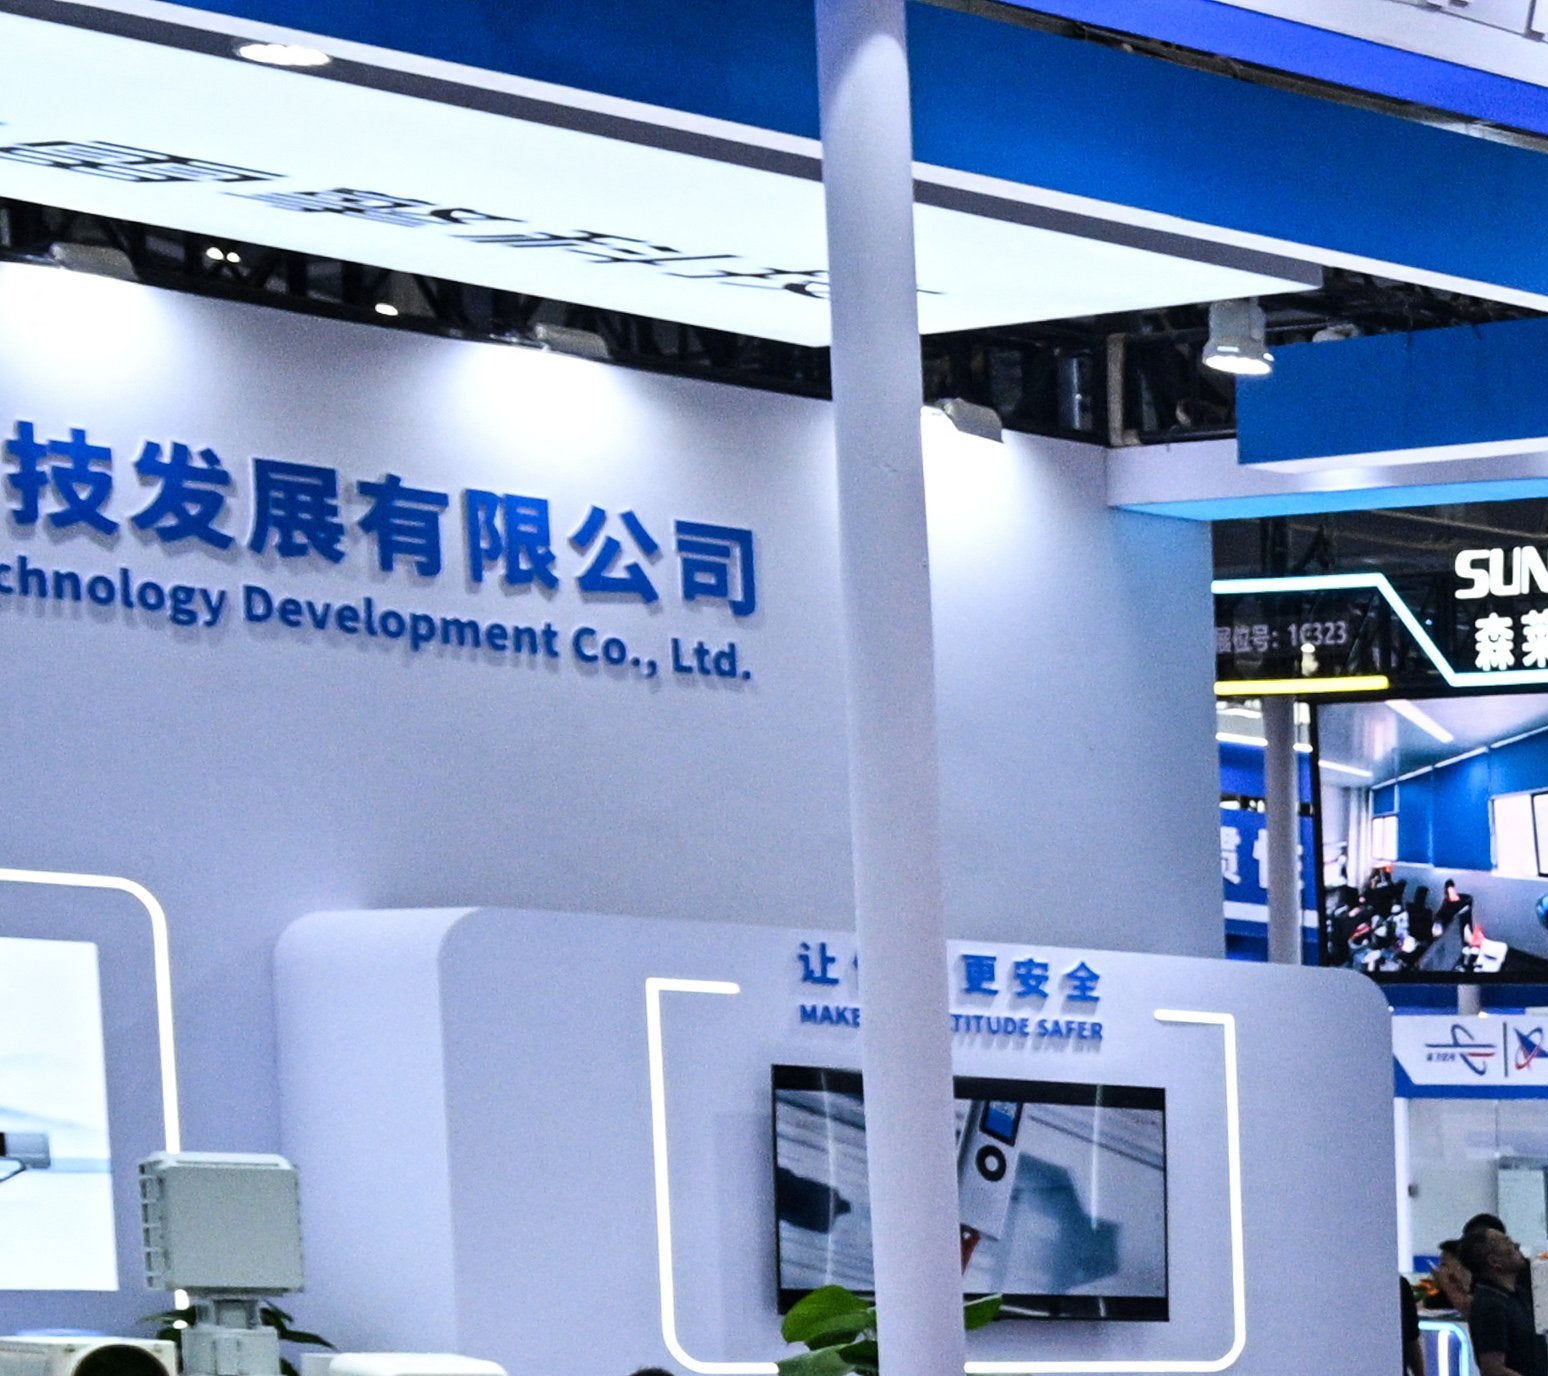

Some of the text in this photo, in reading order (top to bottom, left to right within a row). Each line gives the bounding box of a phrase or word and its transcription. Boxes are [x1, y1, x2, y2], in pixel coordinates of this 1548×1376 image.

[5, 420, 757, 617] 技发展有限公司
[243, 584, 559, 657] Development
[572, 626, 658, 678] Co.,
[671, 638, 752, 681] Ltd.
[799, 1003, 1104, 1040] MAKE TITUDE SAFER
